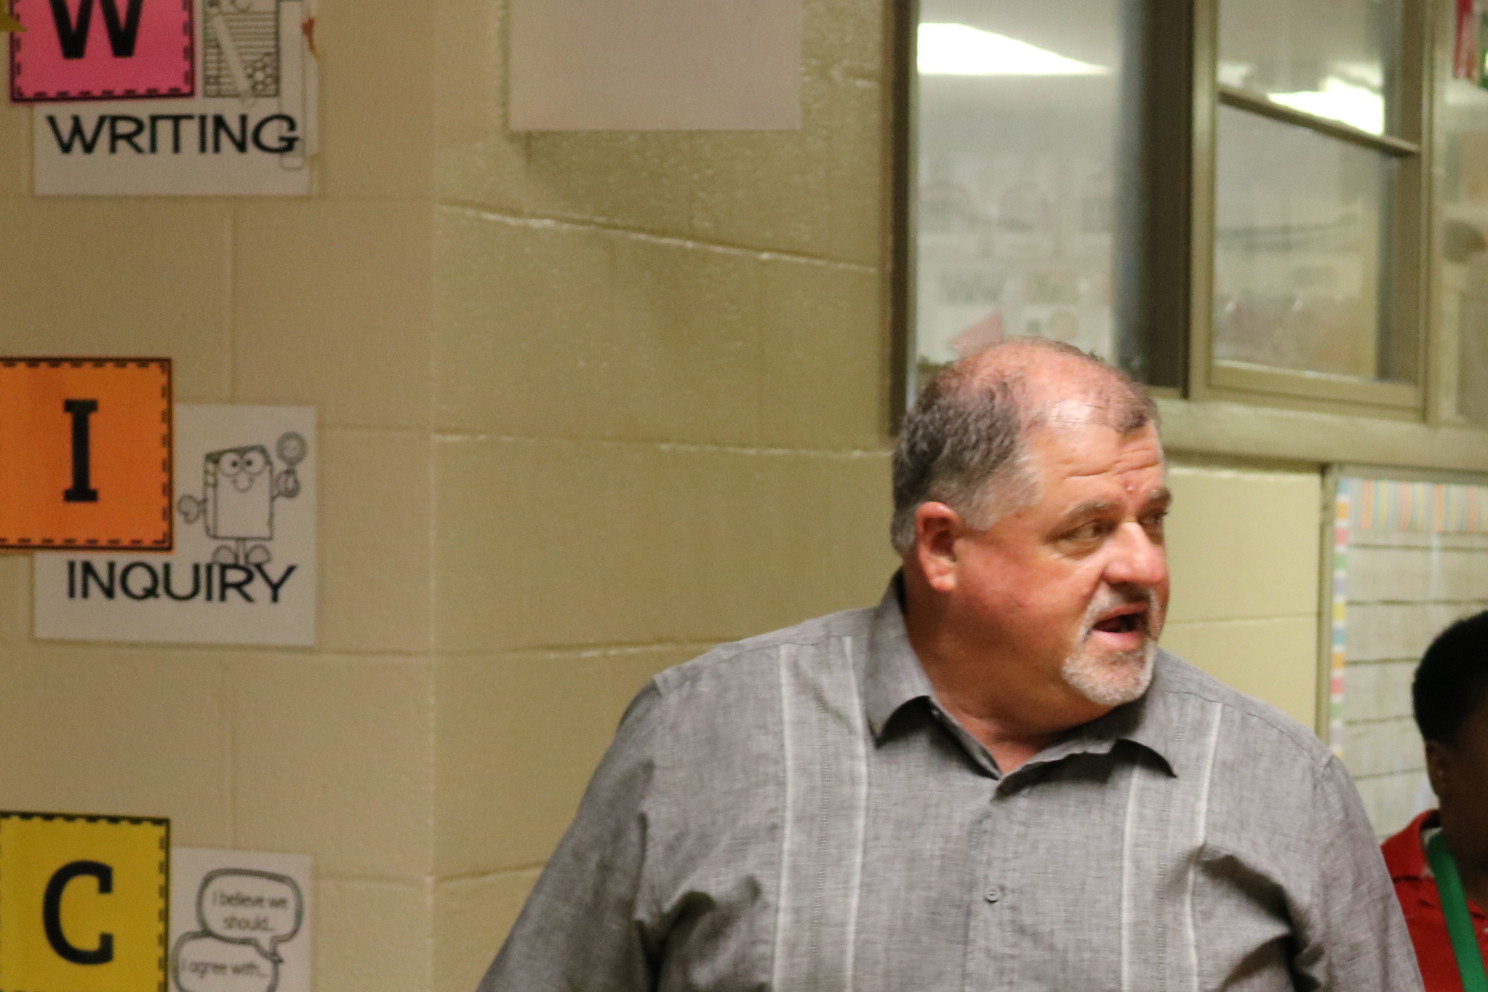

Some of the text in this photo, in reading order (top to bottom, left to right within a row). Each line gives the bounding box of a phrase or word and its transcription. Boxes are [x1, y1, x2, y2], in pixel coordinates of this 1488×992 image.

[48, 0, 144, 59] W
[46, 114, 302, 155] WRITING
[63, 399, 98, 503] I
[67, 560, 298, 603] INQUIRY
[42, 859, 114, 965] C
